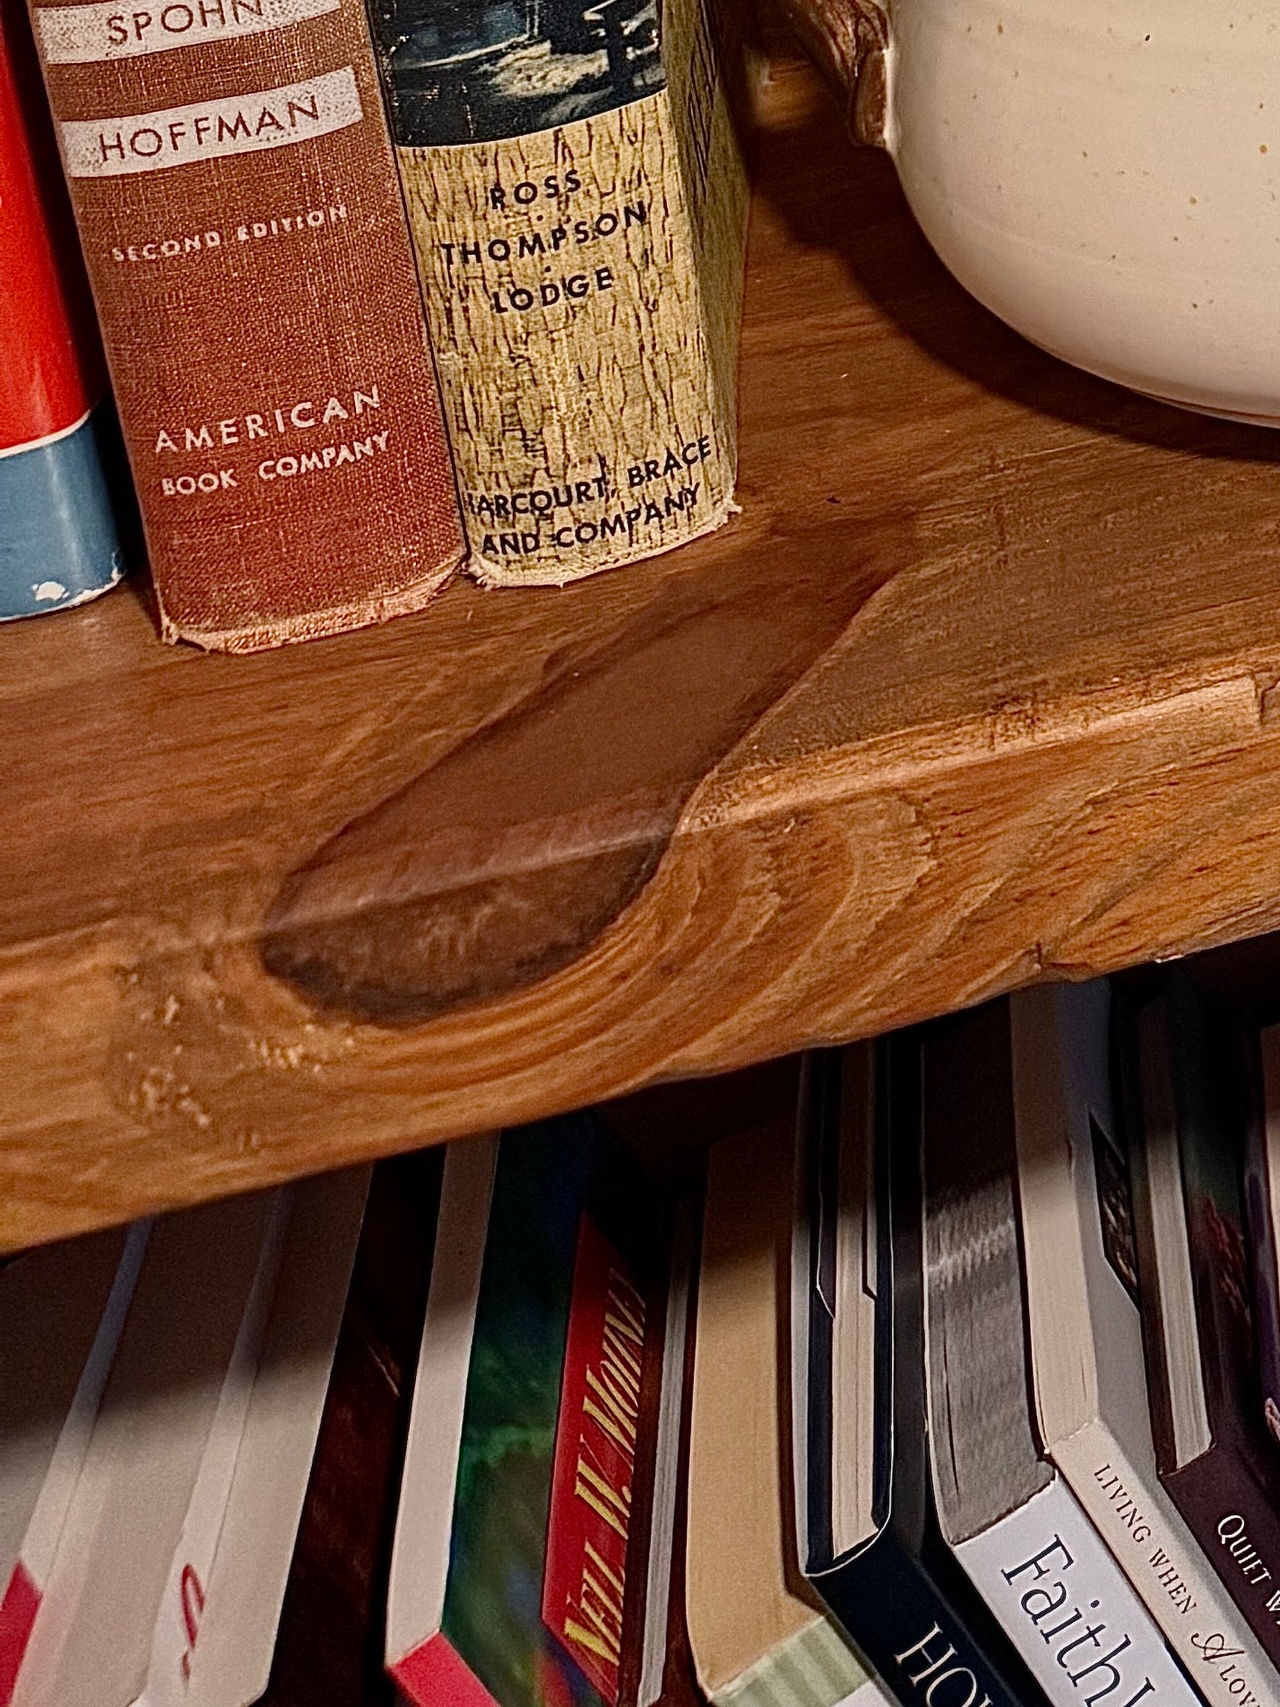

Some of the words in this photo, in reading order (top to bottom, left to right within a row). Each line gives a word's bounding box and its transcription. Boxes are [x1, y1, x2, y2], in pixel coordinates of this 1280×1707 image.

[98, 95, 320, 164] HOFFMAN
[490, 169, 582, 210] ROSS
[110, 230, 222, 263] SECOND
[236, 204, 349, 243] EDITION
[441, 200, 648, 267] THOMPSON
[493, 266, 615, 314] LODGE
[155, 385, 381, 453] AMERICAN
[161, 468, 238, 496] BOOK
[258, 430, 389, 481] COMPANY
[627, 434, 713, 488] BRACE
[482, 532, 541, 556] AND
[555, 482, 701, 549] COMPANY
[575, 1433, 633, 1540] W.
[1217, 1514, 1273, 1586] QUIET
[1093, 1463, 1152, 1544] LIVING
[1148, 1547, 1197, 1616] WHEN
[1191, 1632, 1245, 1665] A
[1219, 1664, 1260, 1707] LOV
[1000, 1534, 1156, 1707] Faith
[893, 1621, 994, 1707] HO
